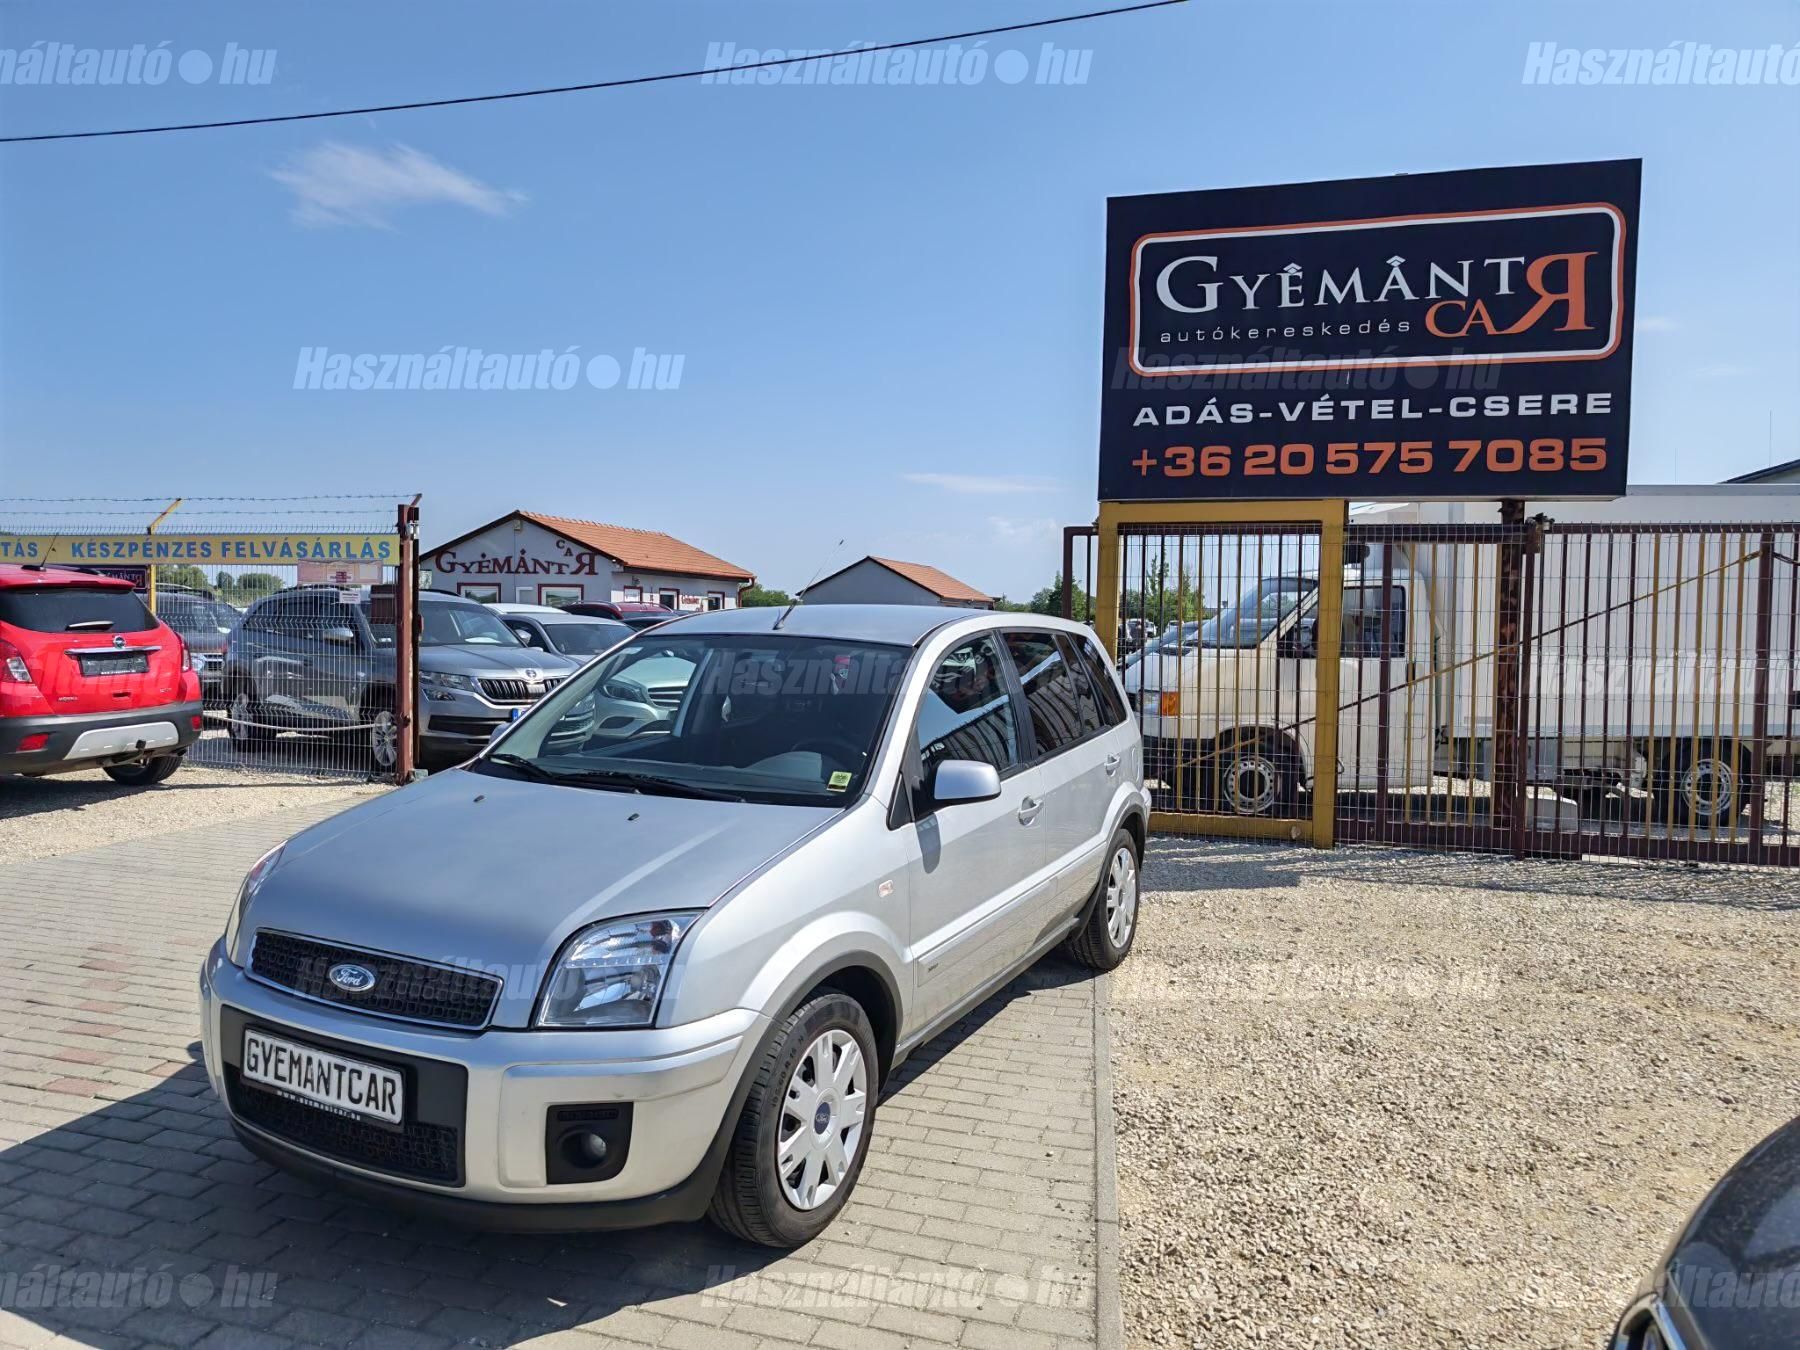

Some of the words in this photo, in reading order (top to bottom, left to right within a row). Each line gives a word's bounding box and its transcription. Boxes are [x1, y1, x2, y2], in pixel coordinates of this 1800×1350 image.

[1160, 318, 1410, 343] autókereskedés
[1133, 393, 1612, 427] ADÁS-VÉTEL-CSERE
[1132, 446, 1232, 477] +36
[1244, 443, 1314, 475] 20
[1326, 441, 1433, 475] 575
[1448, 438, 1608, 473] 7085
[71, 538, 212, 558] KÉSZPÉNZES
[221, 537, 391, 558] FELVÁSÁRLÁS
[336, 968, 364, 986] Ford
[247, 1038, 396, 1115] GYEMANTCAR
